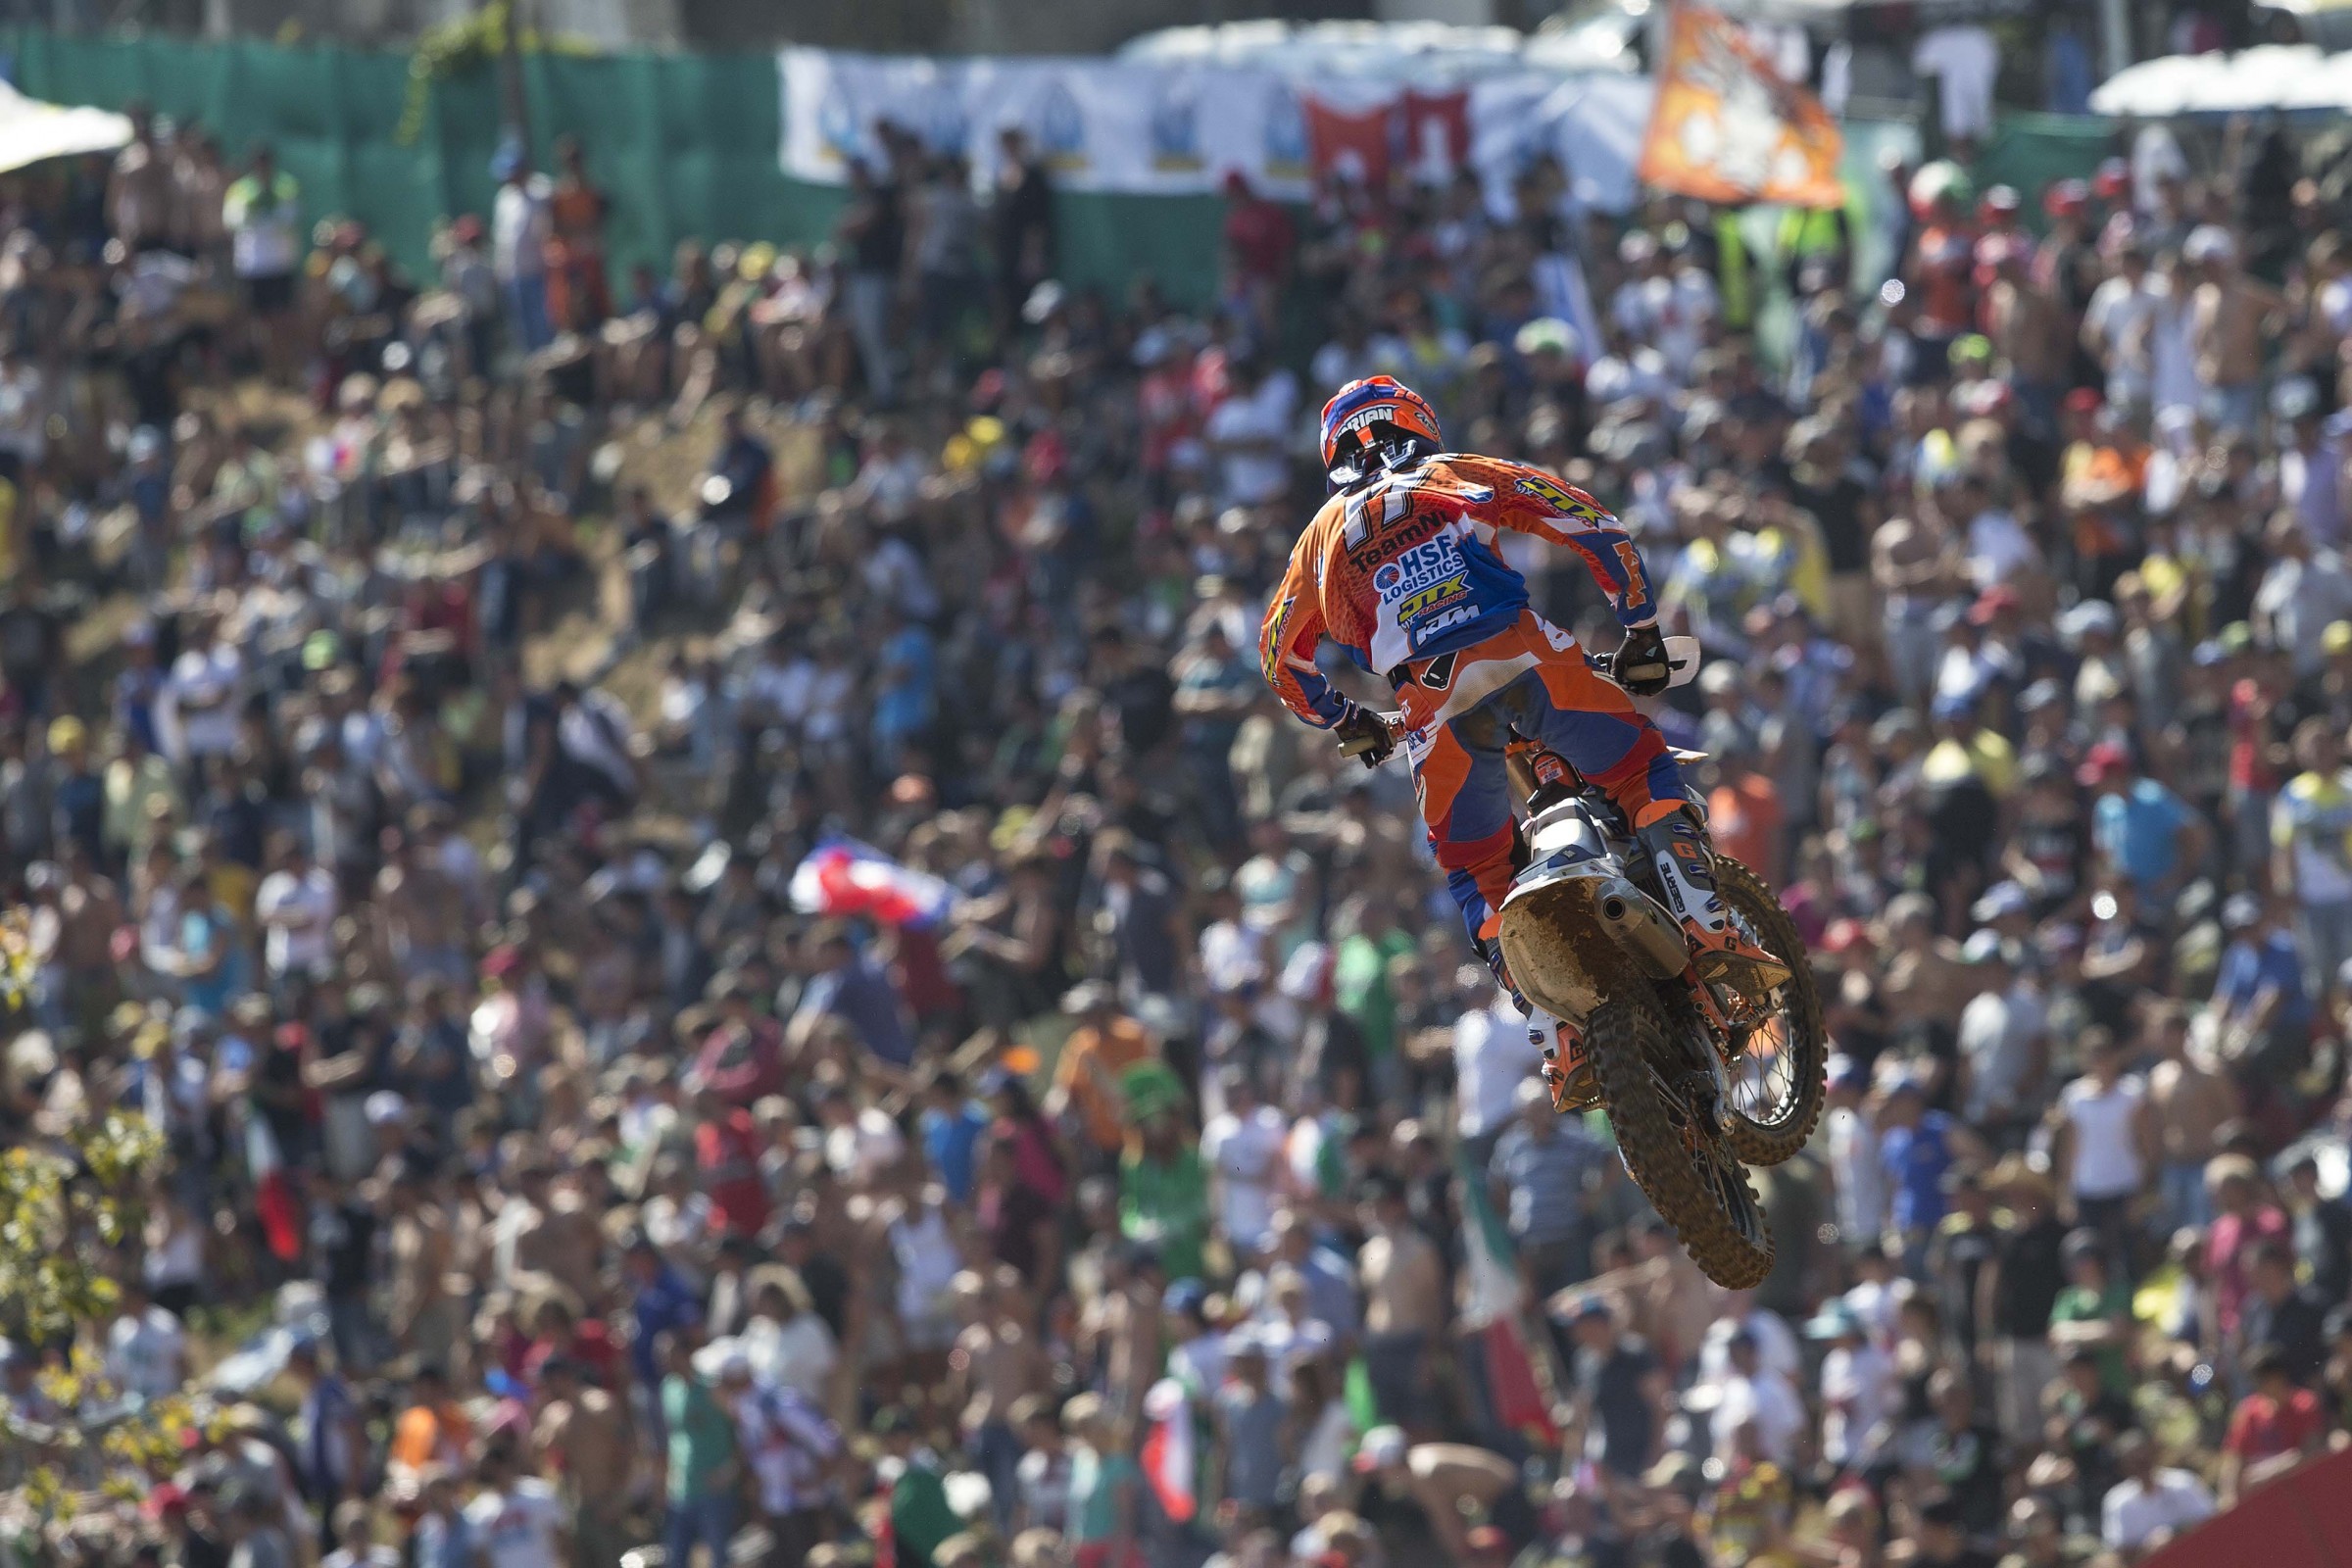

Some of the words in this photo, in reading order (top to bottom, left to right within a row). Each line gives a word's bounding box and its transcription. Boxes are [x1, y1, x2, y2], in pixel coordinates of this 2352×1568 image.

[1399, 534, 1452, 578] HSF
[1382, 553, 1465, 606] LOGISTICS
[1415, 604, 1481, 647] KTM
[1417, 590, 1468, 618] RACING
